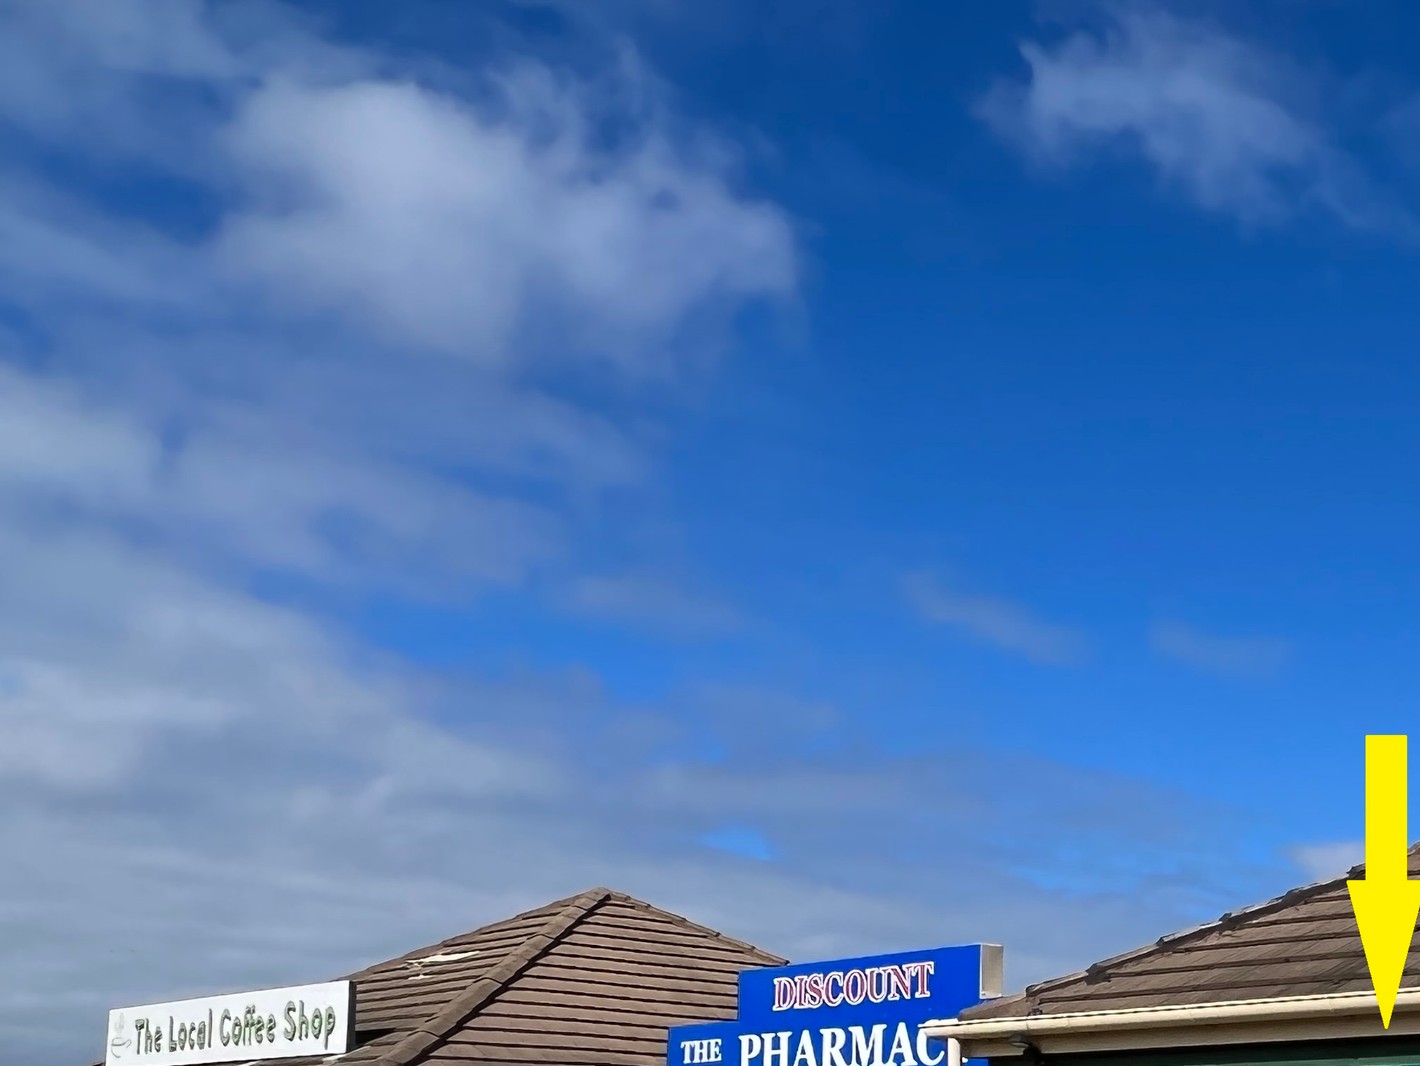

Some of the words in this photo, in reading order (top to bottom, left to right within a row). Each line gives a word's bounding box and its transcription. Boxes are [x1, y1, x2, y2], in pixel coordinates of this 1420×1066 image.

[772, 961, 935, 1011] DISCOUNT
[134, 1017, 163, 1055] The
[169, 1008, 213, 1053] Local
[219, 1004, 277, 1047] Coffee
[283, 999, 336, 1051] Shop
[680, 1038, 723, 1065] THE
